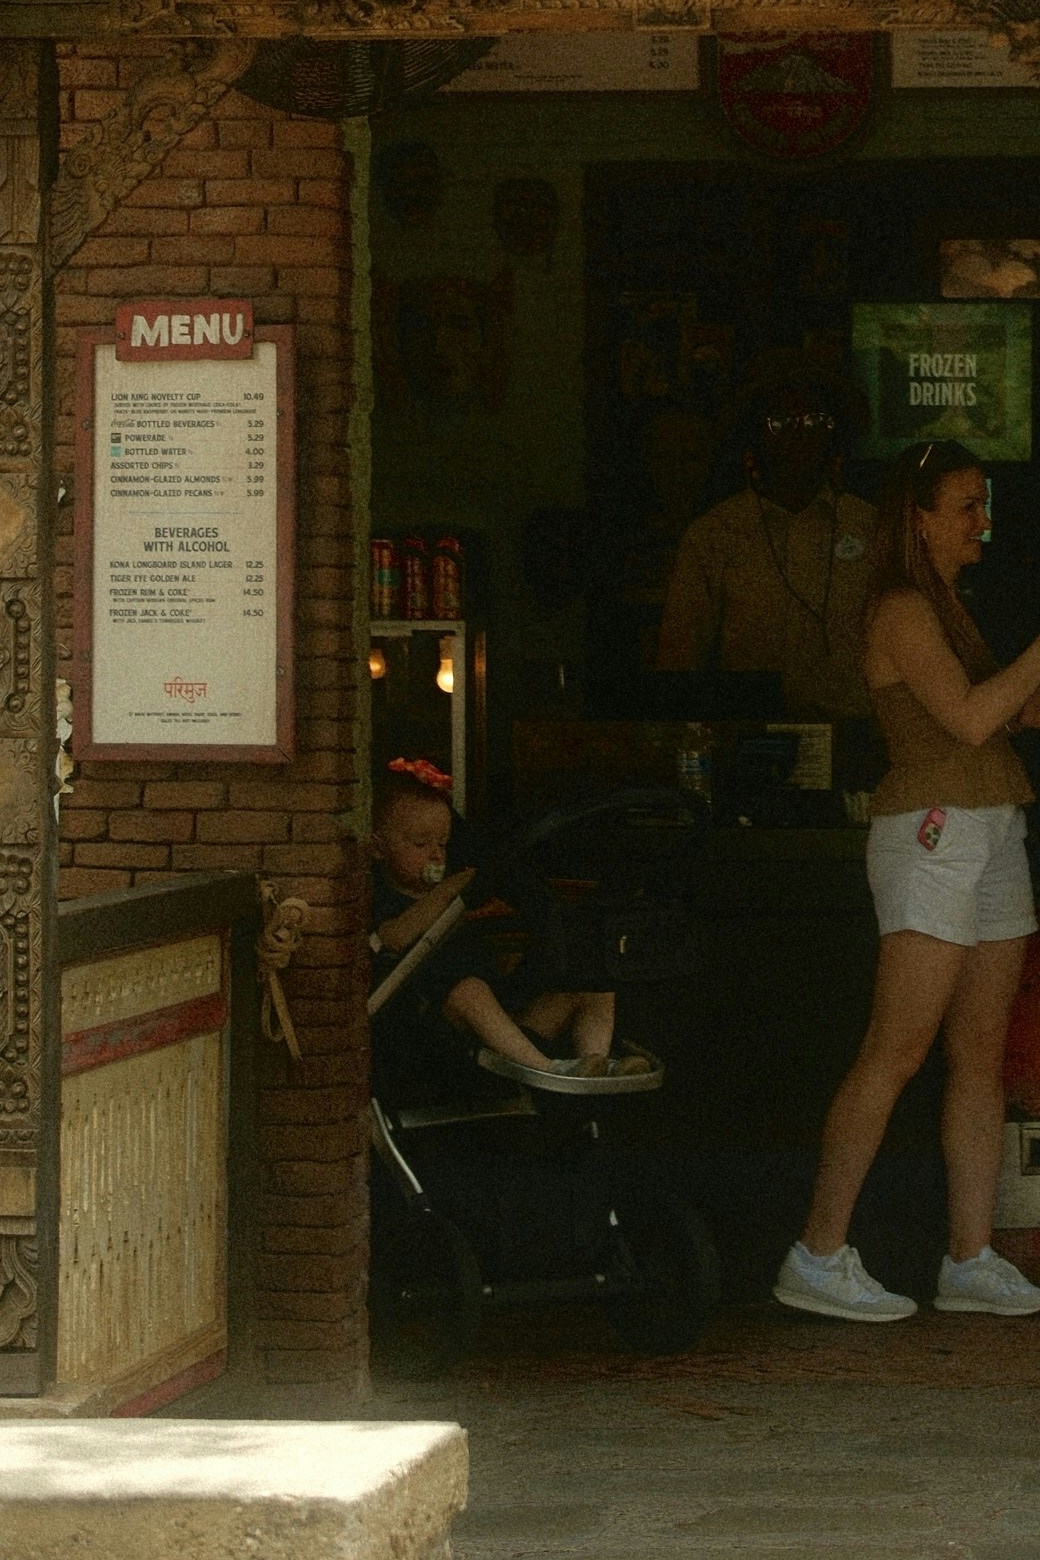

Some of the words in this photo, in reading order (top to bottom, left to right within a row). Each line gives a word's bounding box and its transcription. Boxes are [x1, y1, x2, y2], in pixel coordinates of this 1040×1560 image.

[130, 313, 245, 347] MENU
[909, 353, 978, 378] FROZEN
[111, 393, 128, 401] LION
[131, 393, 149, 401] KING
[151, 393, 184, 401] NOVELTY
[186, 393, 201, 401] CUP
[243, 393, 264, 401] 10.49
[909, 382, 978, 407] DRINKS
[136, 420, 170, 428] BOTTLED
[173, 420, 215, 428] BEVERAGES
[247, 420, 264, 428] 5.29
[125, 434, 166, 442] POWERADE
[247, 434, 264, 442] 5.29
[110, 475, 182, 483] CINNAMON-GLAZED
[184, 475, 220, 483] ALMONDS
[247, 475, 264, 483] 5.99
[110, 489, 182, 497] CINNAMON-GLAZED
[184, 489, 213, 497] PECANS
[247, 489, 264, 497] 5.99
[154, 527, 219, 538] BEVERAGES
[143, 541, 173, 552] WITH
[178, 541, 230, 552] ALCOHOL
[109, 609, 137, 617] FROZEN
[140, 609, 158, 617] JACK
[160, 609, 167, 617] &
[243, 609, 264, 617] 14.50
